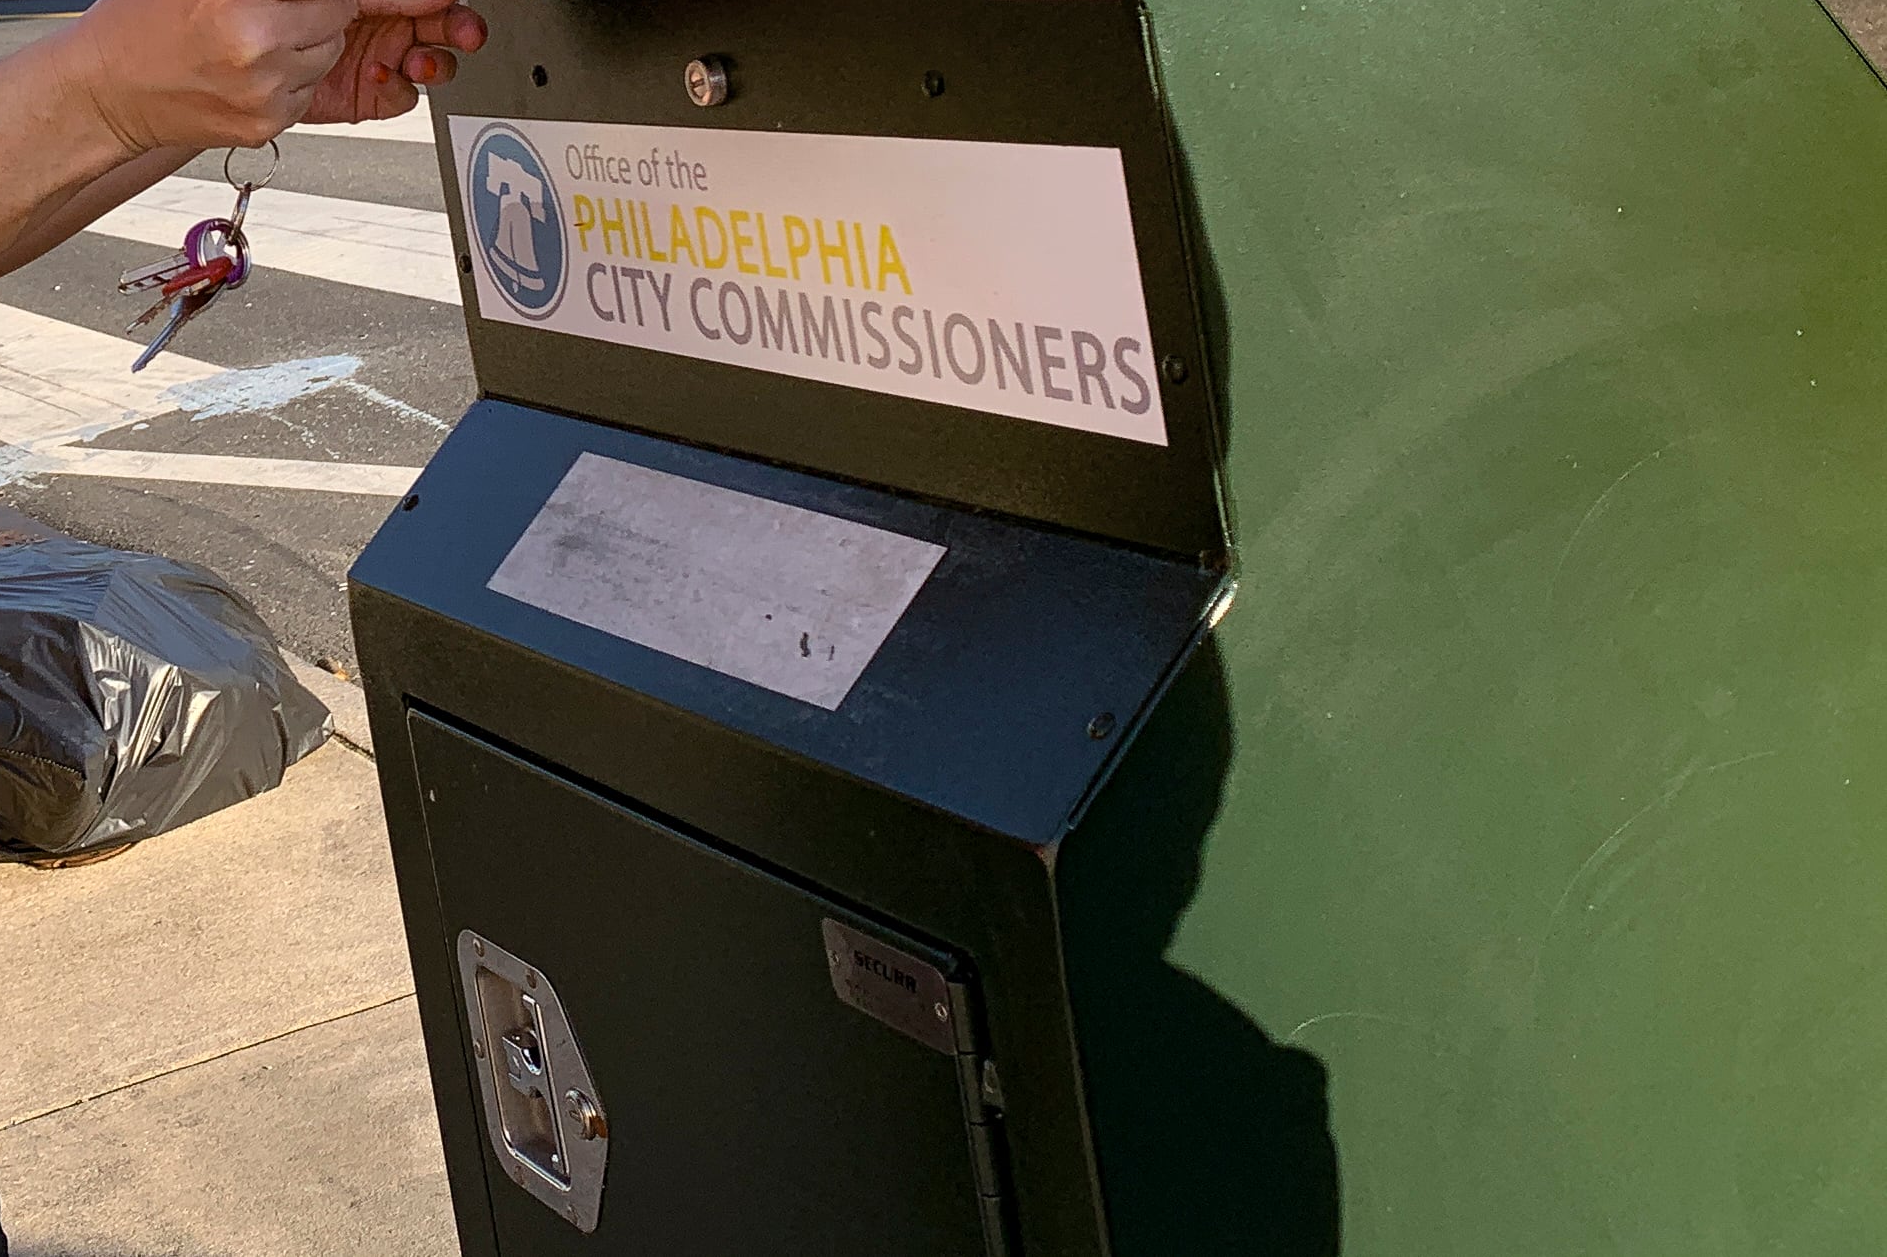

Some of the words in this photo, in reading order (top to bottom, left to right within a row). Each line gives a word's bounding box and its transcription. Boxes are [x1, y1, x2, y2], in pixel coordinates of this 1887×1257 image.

[565, 144, 631, 186] Office
[638, 148, 660, 188] of
[665, 150, 709, 192] the
[573, 194, 913, 296] PHILADELPHIA
[586, 261, 673, 333] CITY
[689, 277, 1152, 416] COMMISSIONERS
